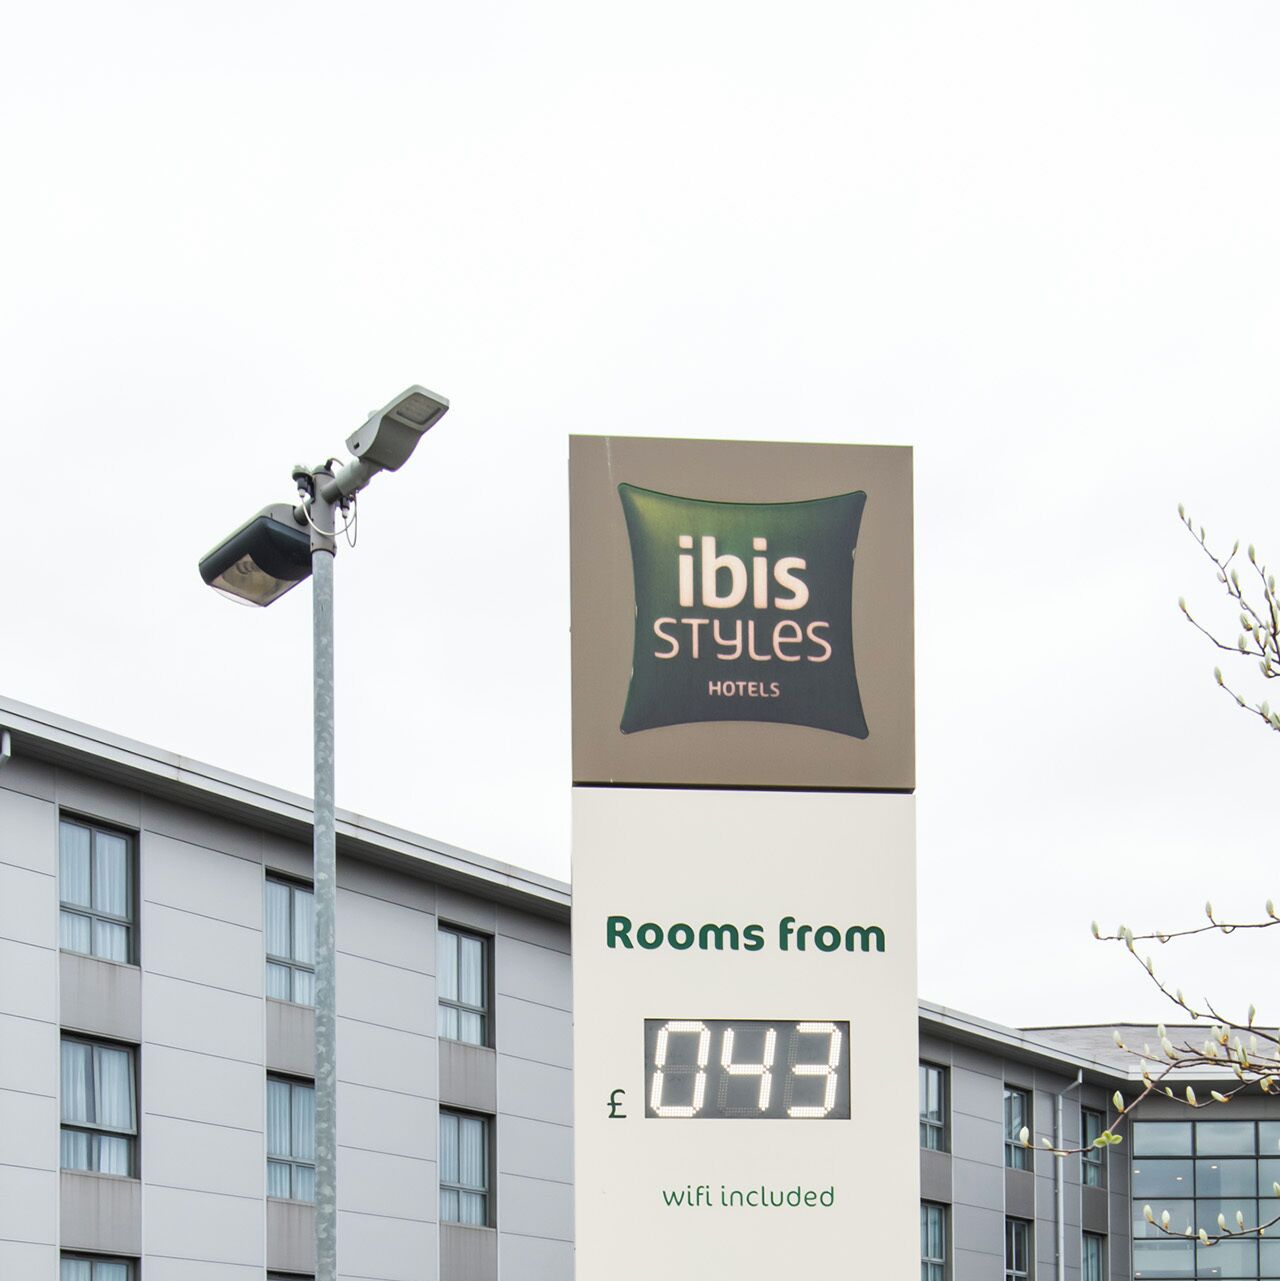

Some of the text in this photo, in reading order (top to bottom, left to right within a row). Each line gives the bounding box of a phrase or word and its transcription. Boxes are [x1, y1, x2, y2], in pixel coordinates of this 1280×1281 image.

[678, 534, 810, 611] ibis
[707, 680, 781, 698] HOTELS
[606, 915, 886, 952] Rooms from
[607, 1020, 843, 1119] £ 043
[662, 1185, 835, 1207] wifi included
